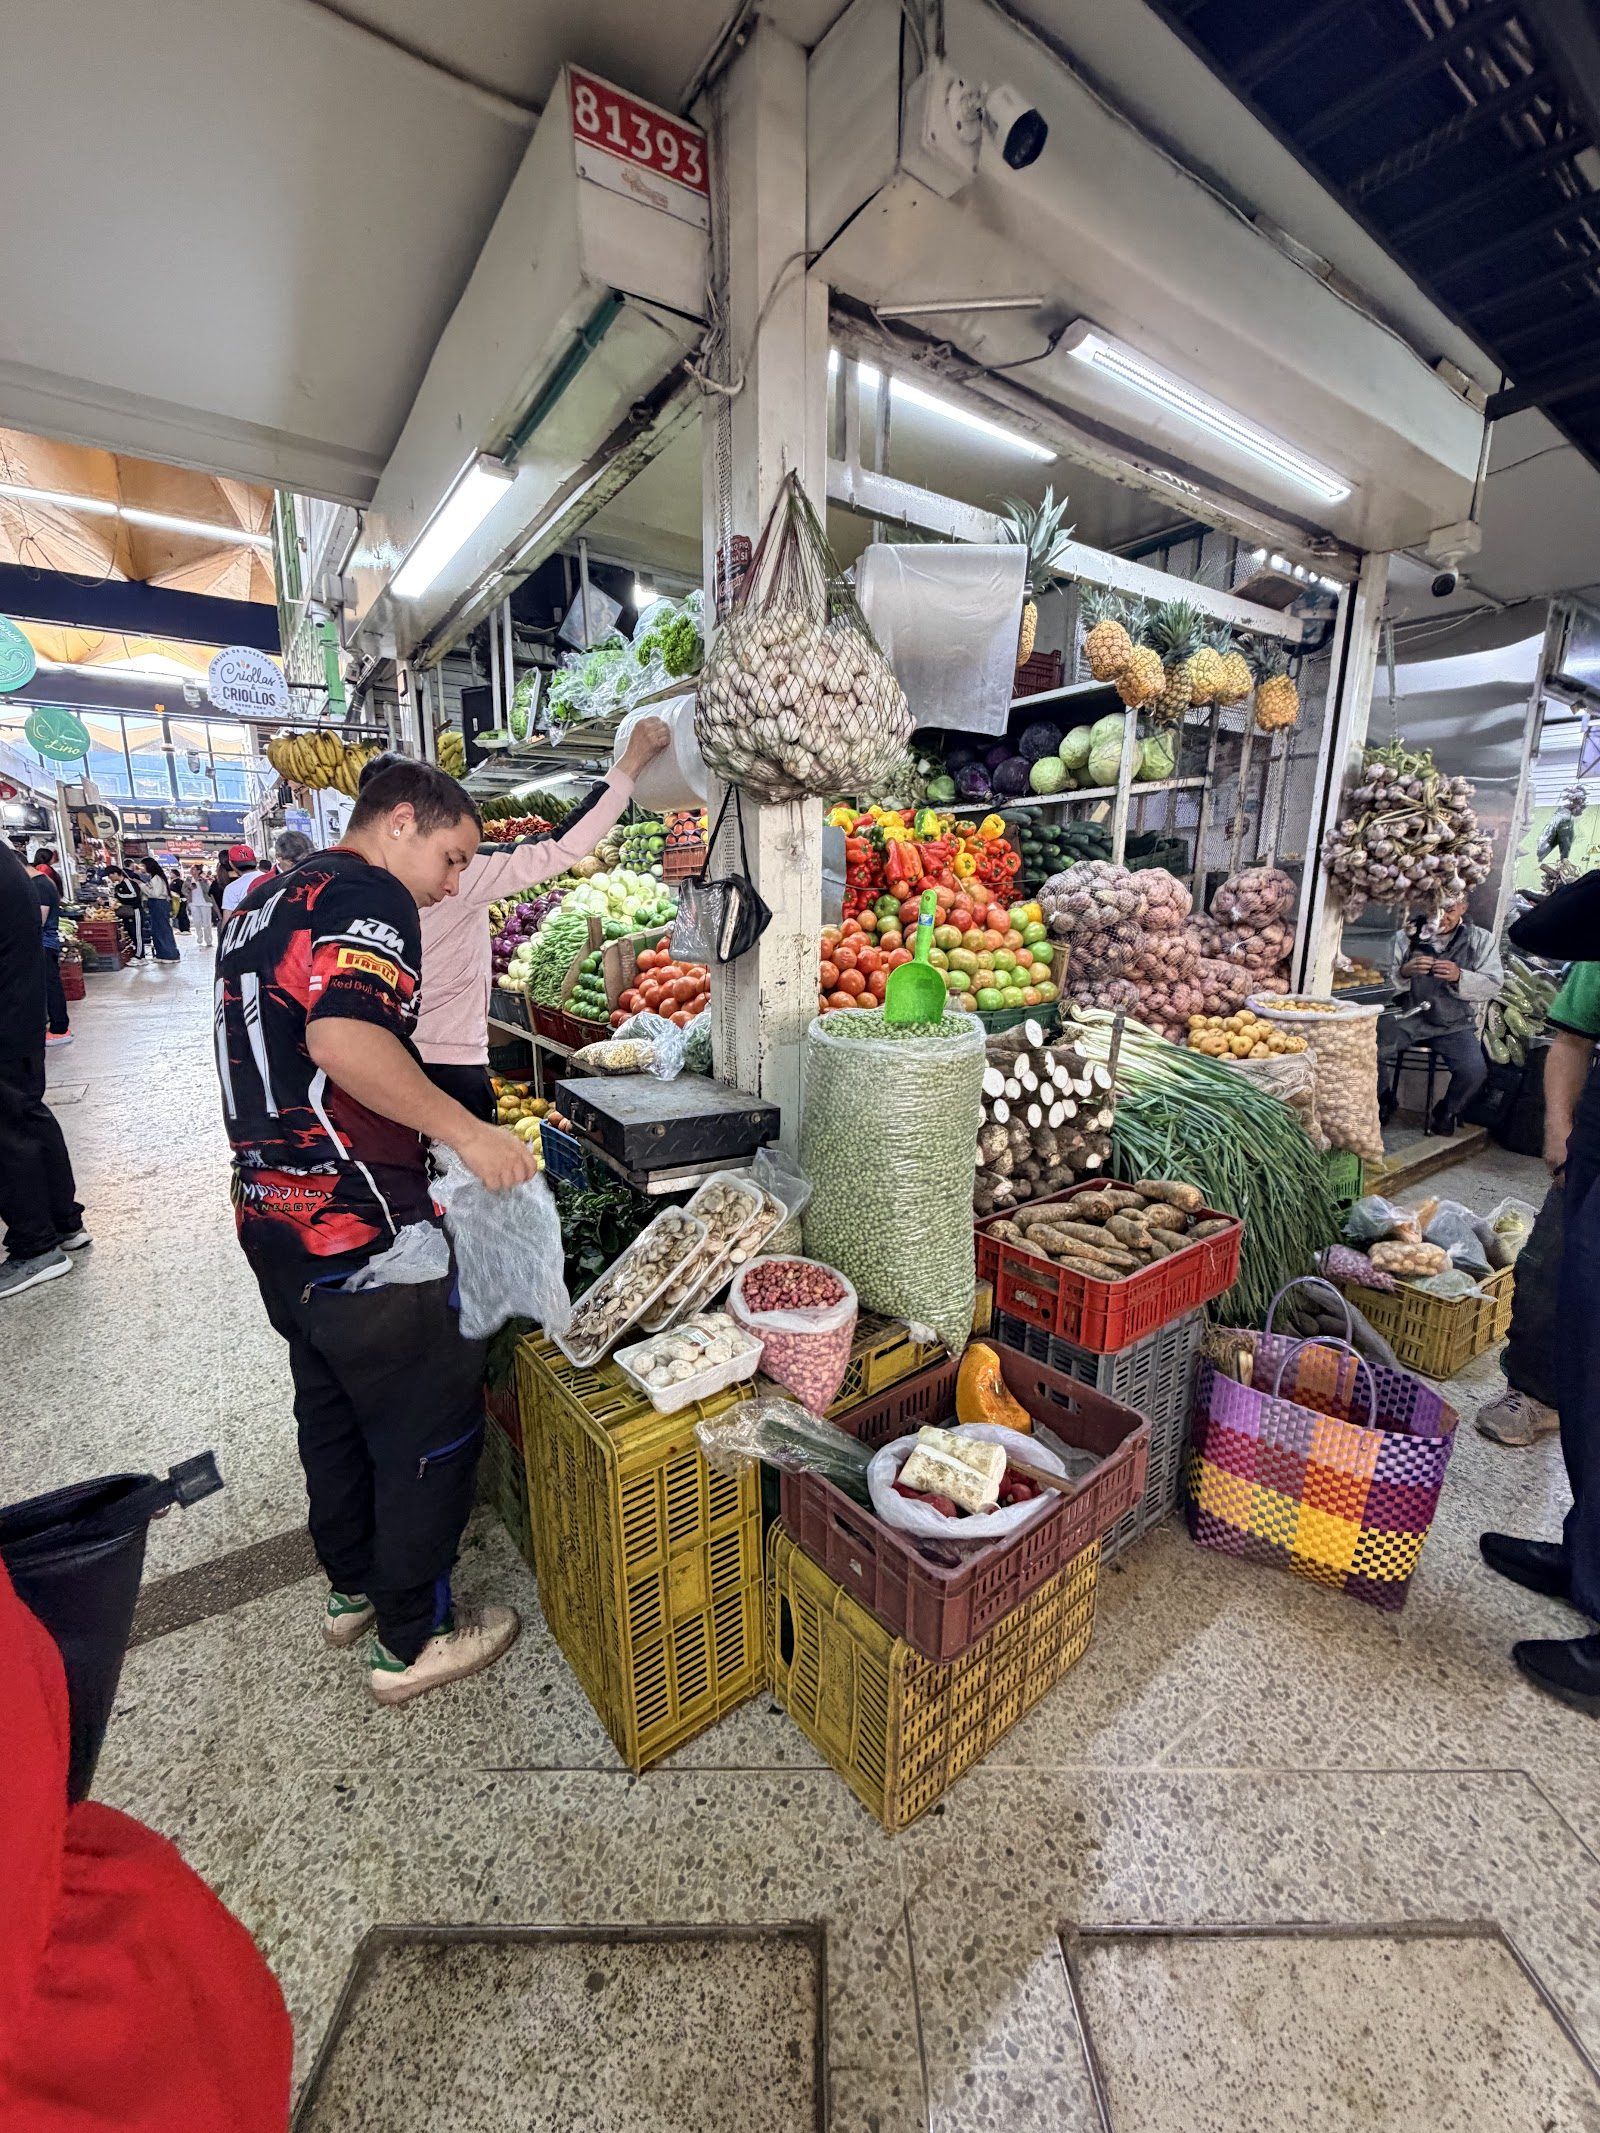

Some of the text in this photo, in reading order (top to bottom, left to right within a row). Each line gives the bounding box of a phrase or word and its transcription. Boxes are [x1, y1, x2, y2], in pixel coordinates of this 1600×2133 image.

[575, 85, 703, 184] 81393
[220, 662, 277, 687] Criollas
[222, 686, 276, 707] CRIOLLOS
[44, 739, 81, 755] Lino
[345, 917, 405, 954] KTM
[344, 952, 397, 983] PIRELLI
[331, 978, 373, 995] Red Bull
